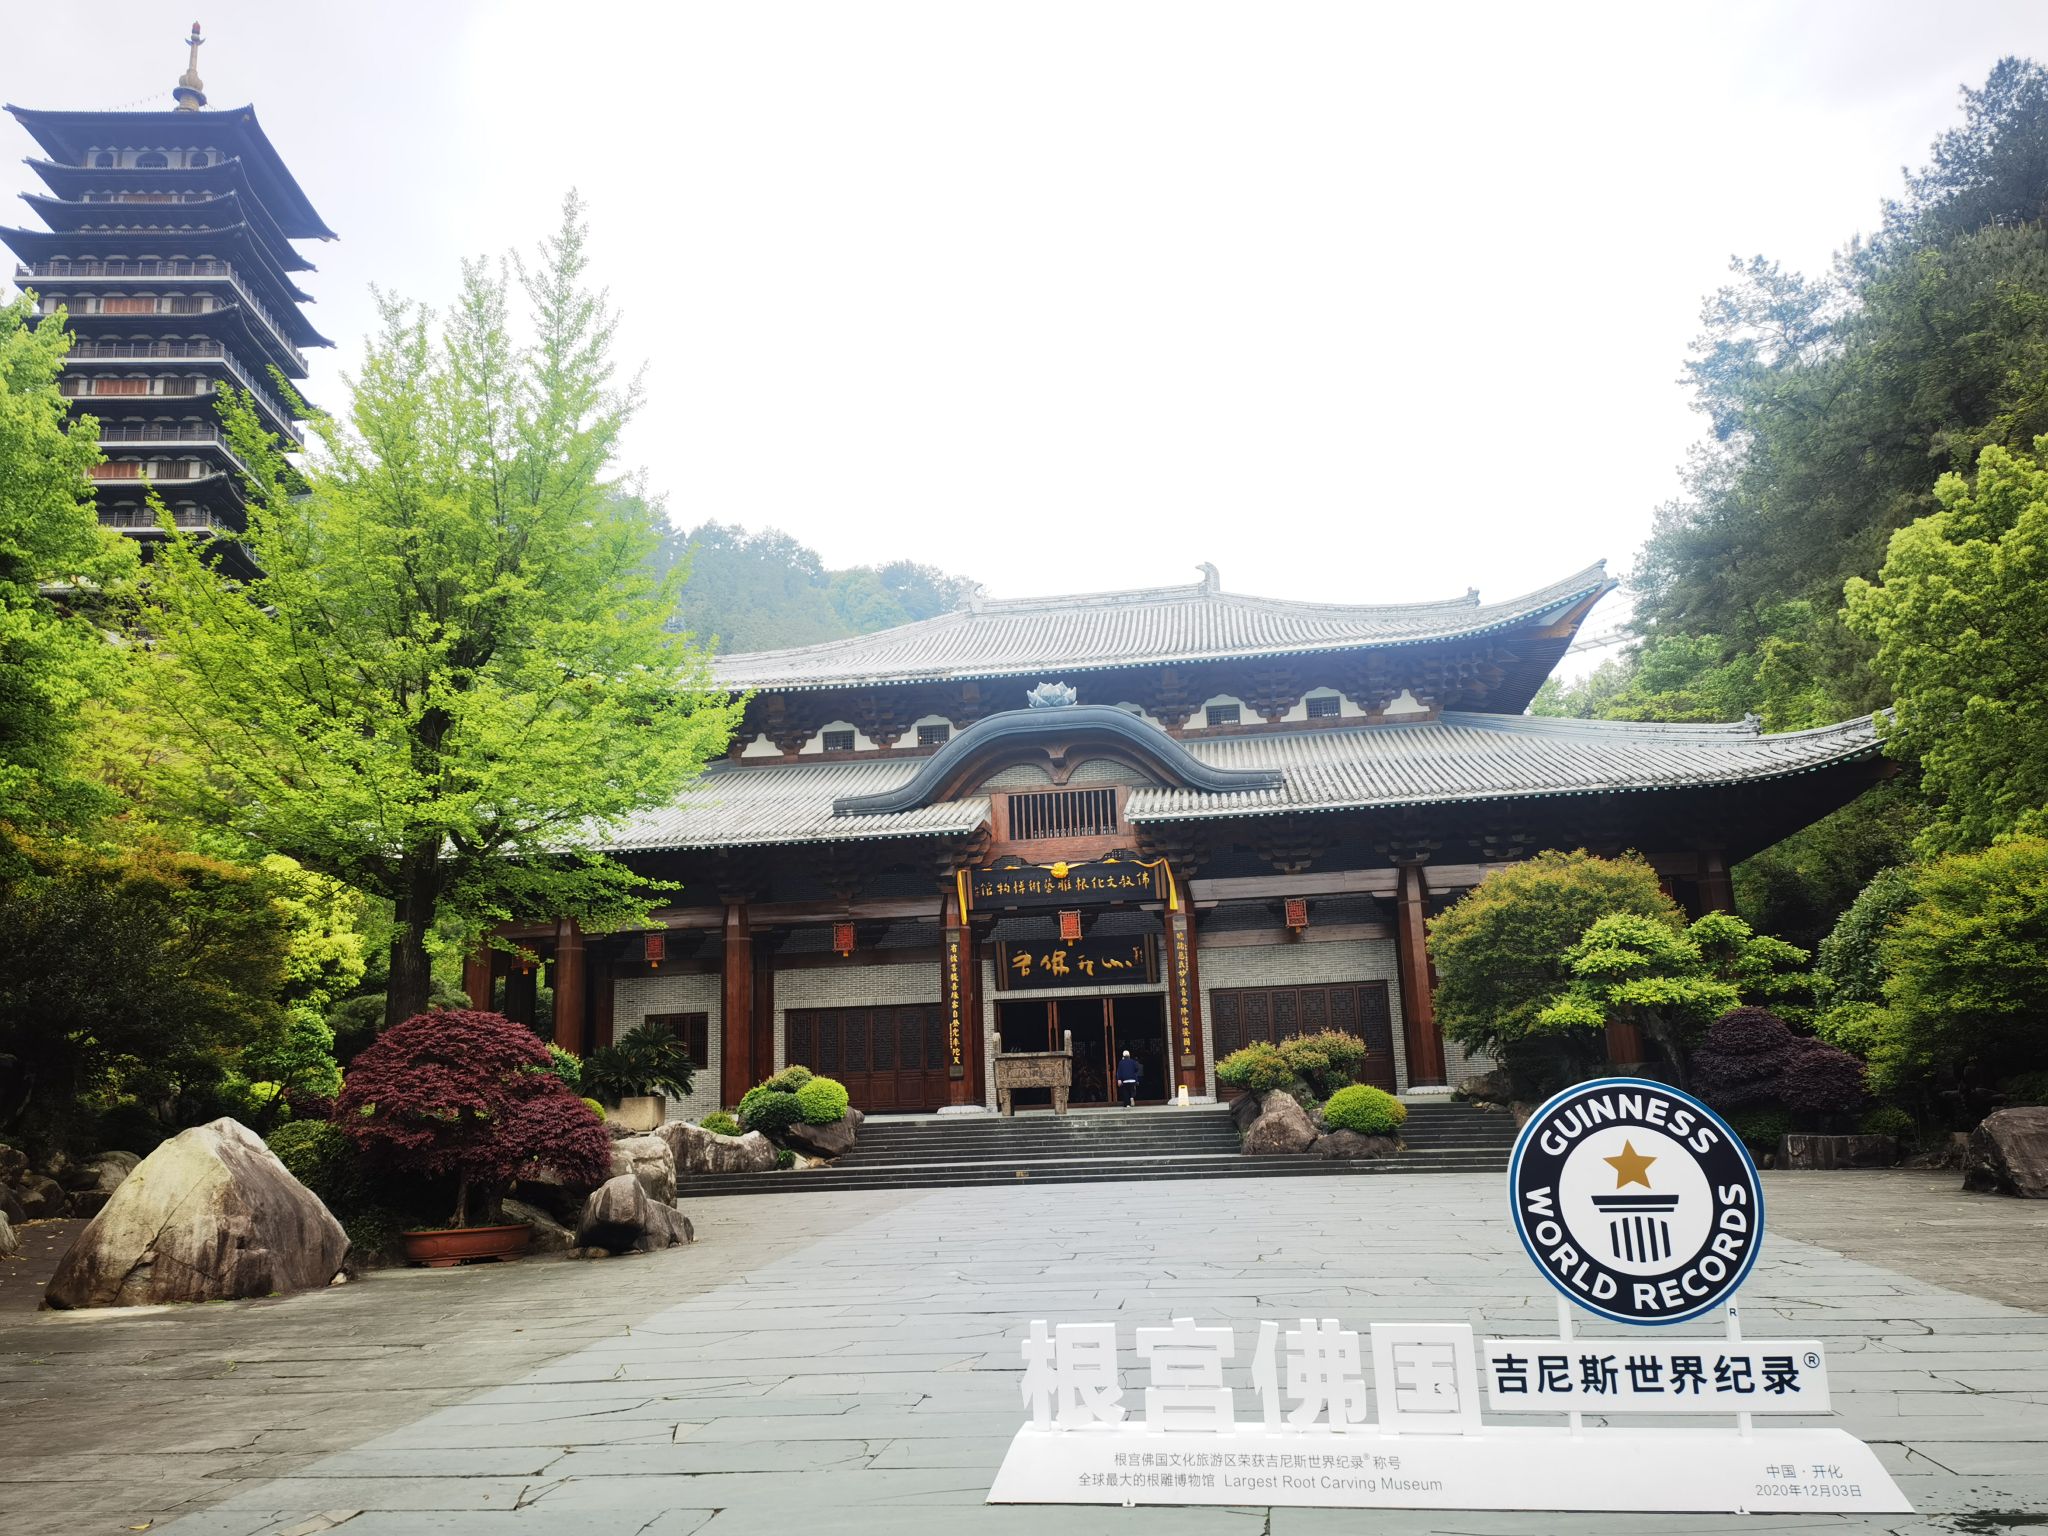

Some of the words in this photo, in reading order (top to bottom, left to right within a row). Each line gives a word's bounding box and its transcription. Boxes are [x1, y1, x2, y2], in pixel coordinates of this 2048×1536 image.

[1540, 1094, 1718, 1155] GUINNESS
[1526, 1187, 1617, 1300] WORLD
[1633, 1183, 1747, 1309] RECORDS
[1021, 1317, 1483, 1435] 根宫佛国
[1079, 1473, 1215, 1488] 全球最大的根雕博物馆
[1224, 1475, 1278, 1490] Largest
[1282, 1476, 1316, 1489] Root
[1321, 1477, 1376, 1493] Carving
[1381, 1477, 1443, 1492] Museum
[1755, 1484, 1862, 1497] 2020年12月03日
